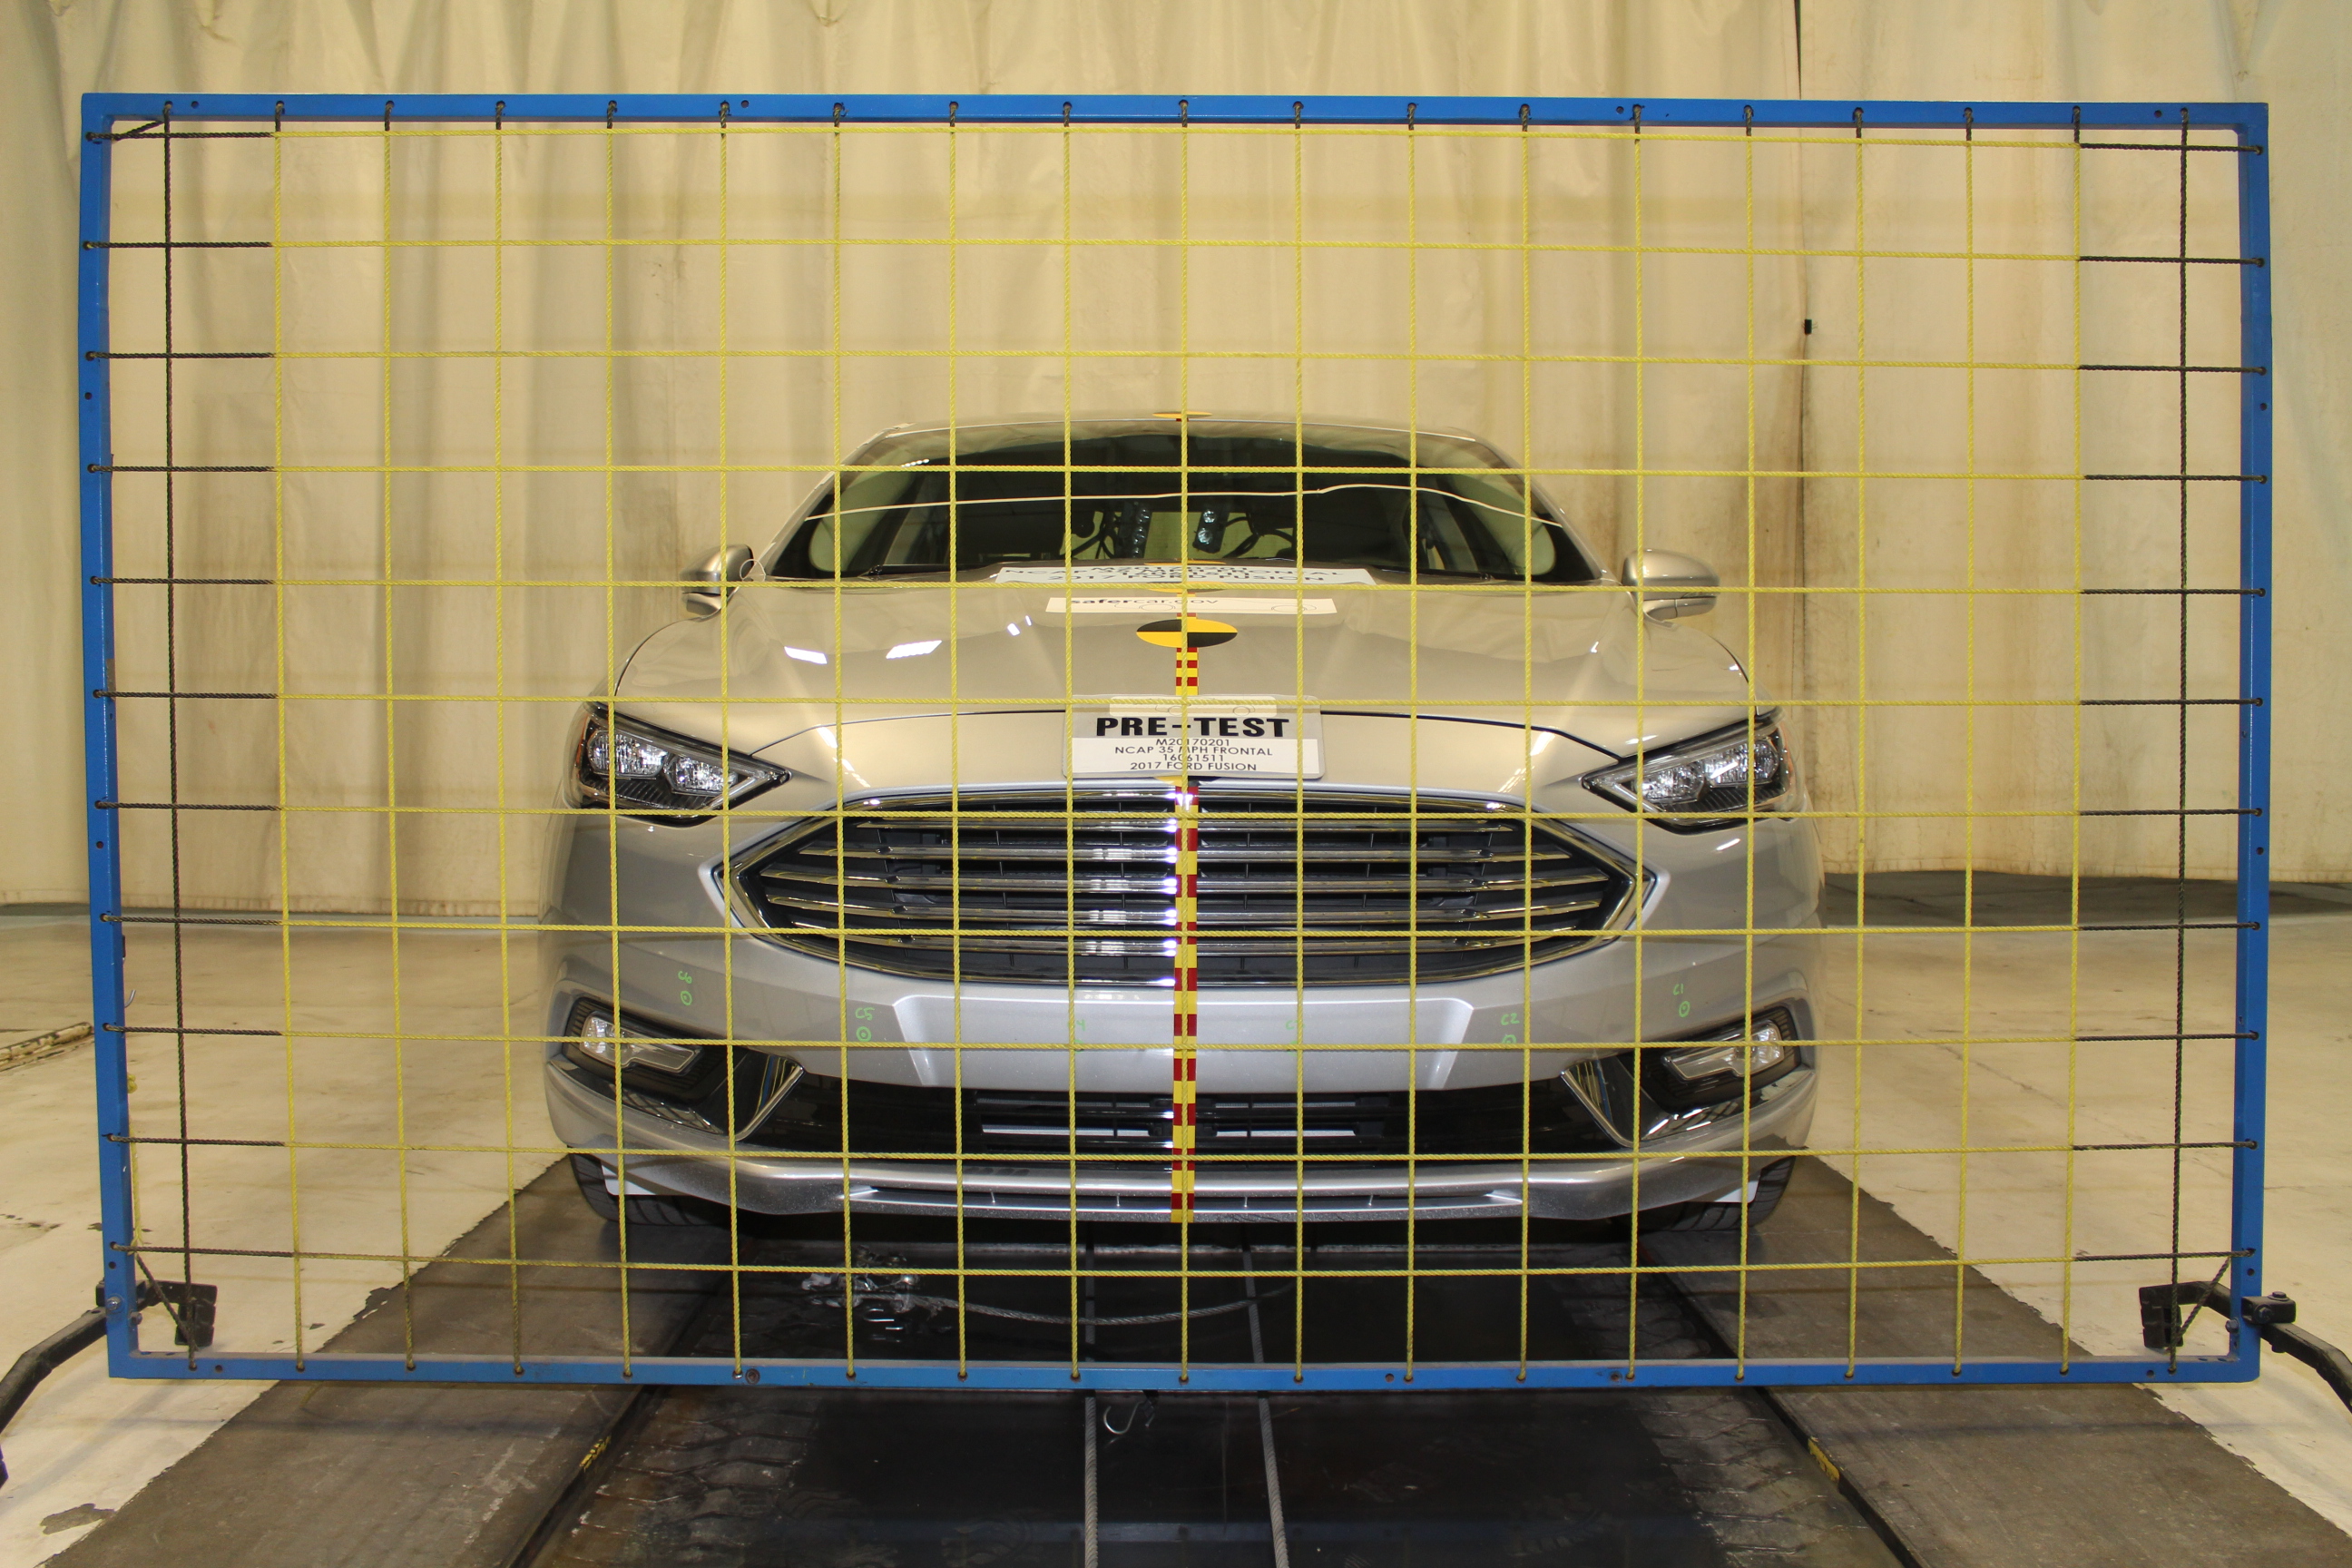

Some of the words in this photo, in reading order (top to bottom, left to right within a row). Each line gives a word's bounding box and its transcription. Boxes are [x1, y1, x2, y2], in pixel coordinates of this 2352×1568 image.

[1096, 717, 1289, 738] PRE-TEST
[1156, 738, 1230, 747] M20170201
[1114, 746, 1154, 754] NCAP
[1158, 746, 1174, 754] 35
[1213, 747, 1273, 756] FRONTAL
[1163, 753, 1223, 762] 16061511
[1130, 761, 1161, 770] 2017
[1166, 761, 1203, 770] FORD
[1208, 762, 1257, 771] FUSION
